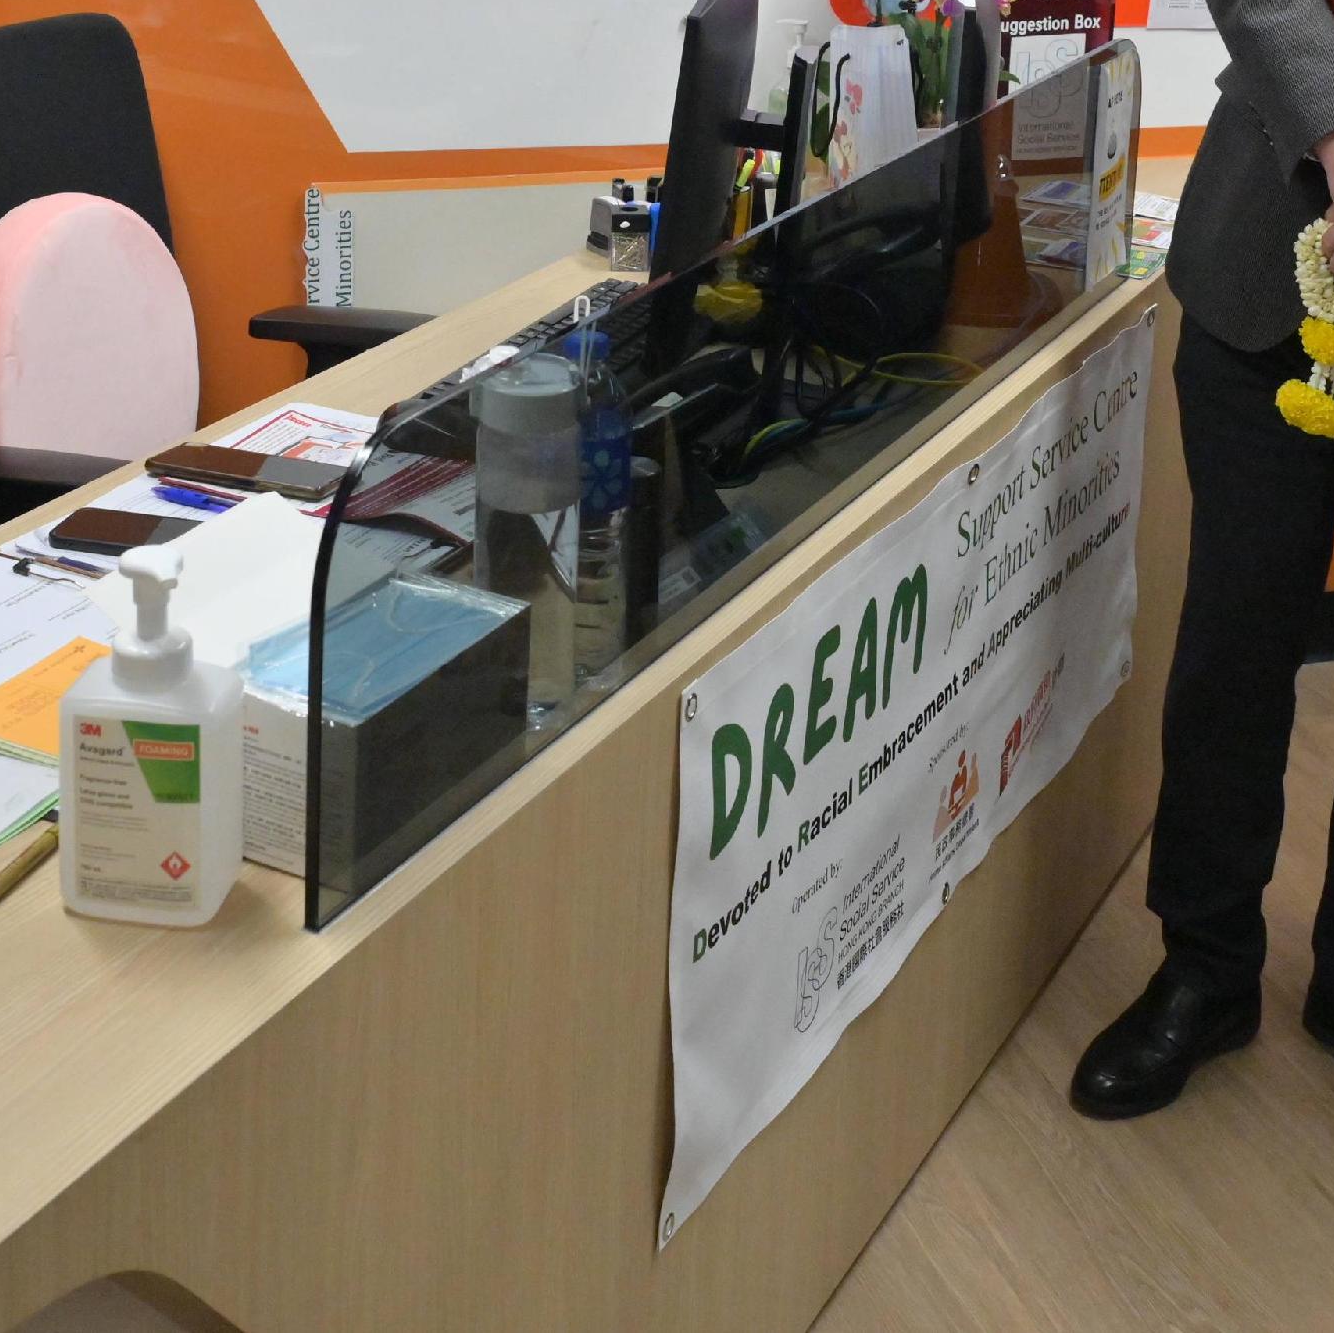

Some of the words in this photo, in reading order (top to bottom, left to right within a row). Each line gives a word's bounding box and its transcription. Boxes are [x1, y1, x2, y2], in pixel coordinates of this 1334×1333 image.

[1000, 15, 1069, 36] uggestion
[1074, 13, 1101, 30] Box
[304, 188, 320, 251] Centre
[304, 260, 320, 304] rvice
[336, 209, 352, 307] Minorities
[957, 465, 1026, 558] Support
[1030, 415, 1088, 490] Service
[944, 584, 979, 655] for
[984, 523, 1038, 606] Ethnic
[1043, 449, 1121, 547] Minorities
[79, 722, 102, 737] 3M
[709, 564, 928, 860] DREAM
[79, 743, 123, 756] Avagard
[693, 860, 772, 963] Devoted
[778, 844, 793, 878] to
[797, 777, 852, 853] Racial
[858, 673, 960, 796] Embracement
[962, 642, 986, 688] and
[987, 569, 1063, 659] Appreciating
[791, 872, 829, 914] Operated
[840, 898, 871, 942] Social
[871, 856, 905, 906] Service
[843, 834, 901, 914] International
[838, 932, 858, 965] HONG
[858, 910, 878, 938] KONG
